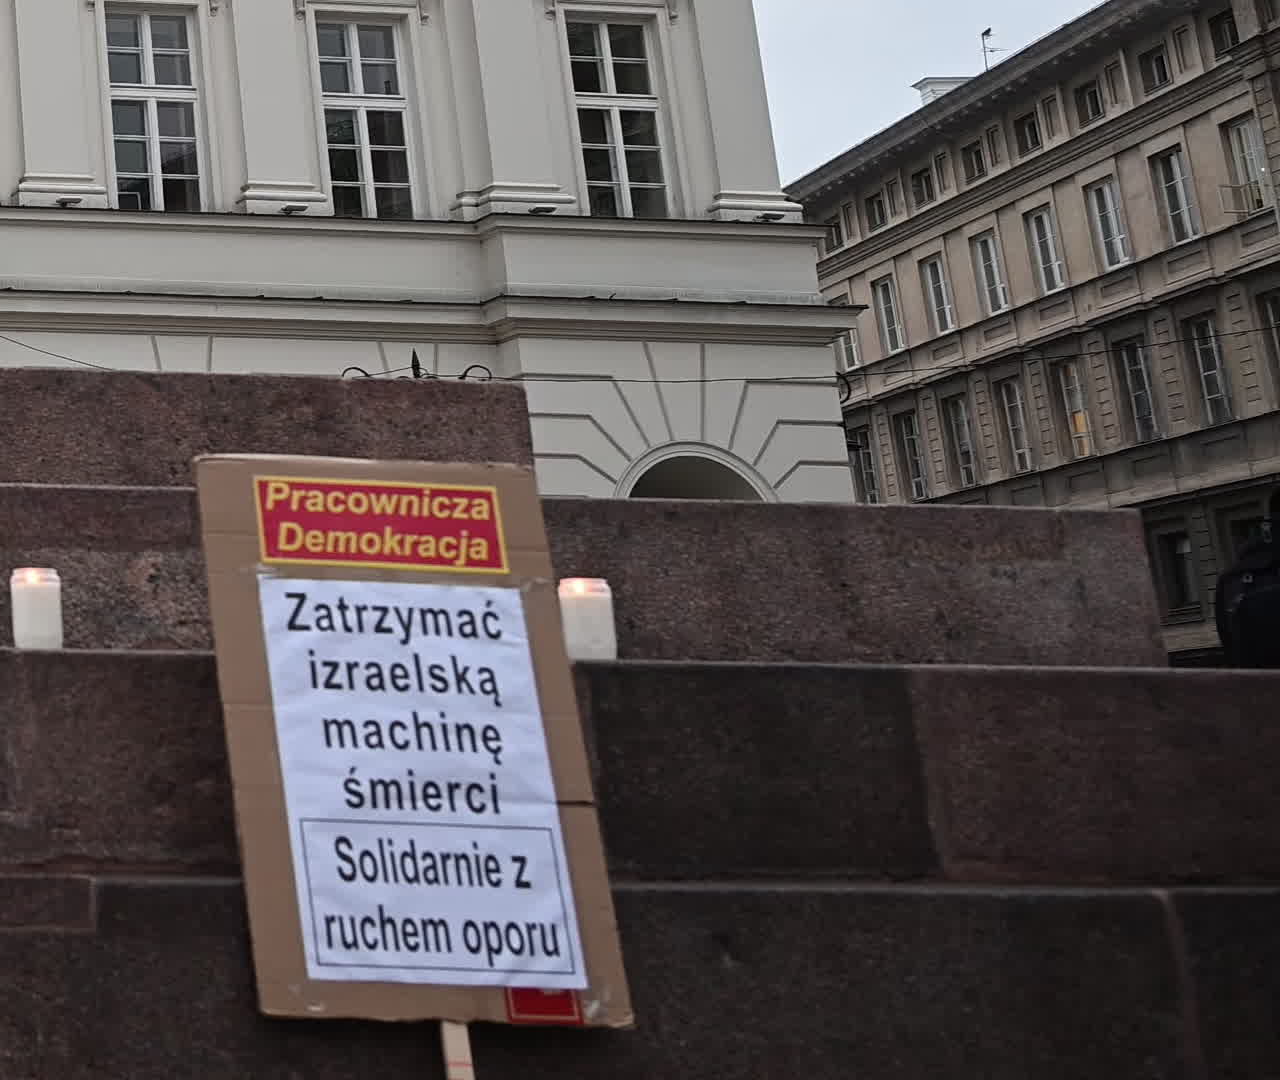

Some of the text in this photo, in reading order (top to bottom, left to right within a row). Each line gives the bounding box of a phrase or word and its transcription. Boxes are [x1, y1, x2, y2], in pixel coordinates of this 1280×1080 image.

[264, 481, 491, 521] Pracownicza
[277, 521, 490, 561] Demokracja
[285, 592, 502, 646] Zatrzymać
[308, 649, 503, 708] izraelską
[323, 711, 502, 766] machinę
[343, 766, 501, 815] śmierci
[334, 835, 532, 889] Solidarnie z
[324, 904, 562, 967] ruchem oporu
